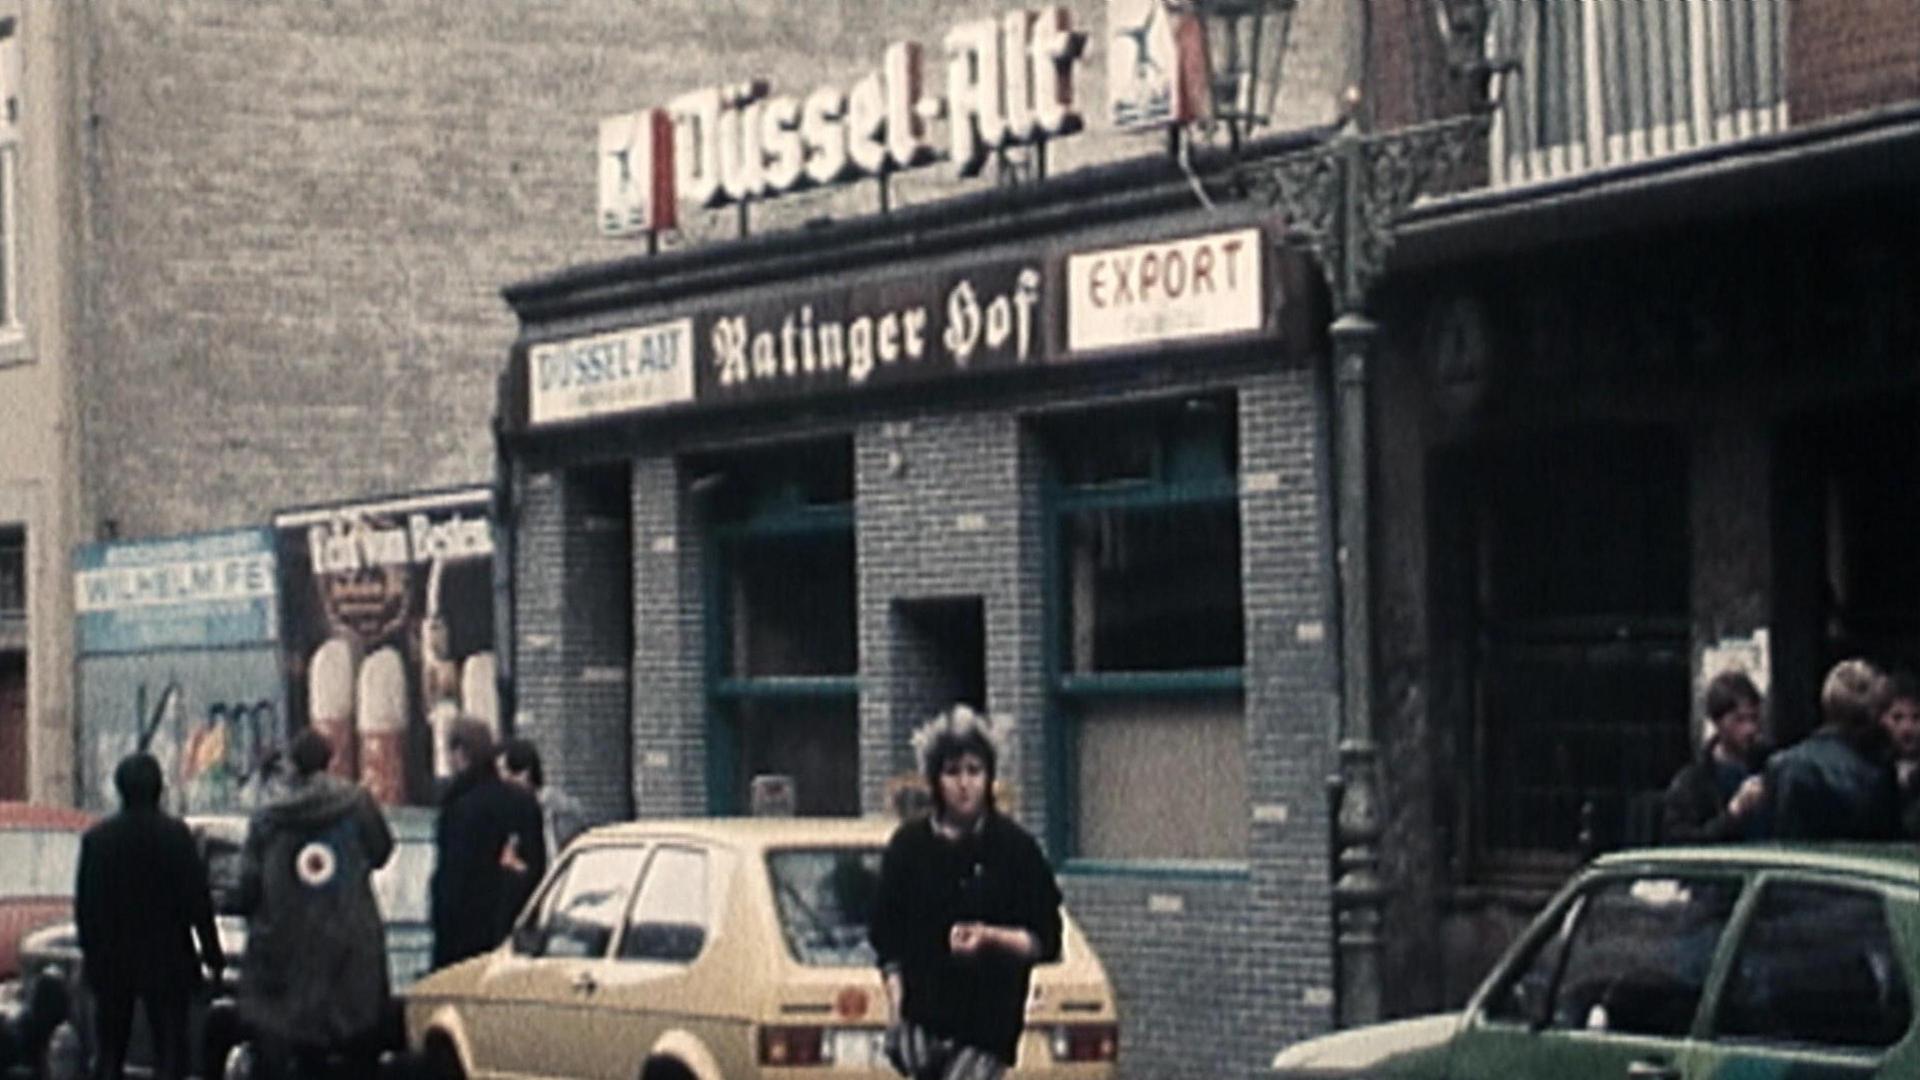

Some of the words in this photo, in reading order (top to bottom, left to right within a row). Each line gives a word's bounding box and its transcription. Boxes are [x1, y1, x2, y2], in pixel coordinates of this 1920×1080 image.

[1089, 239, 1243, 309] EXPORT
[712, 304, 926, 384] Ratinger
[943, 268, 1039, 367] Hof
